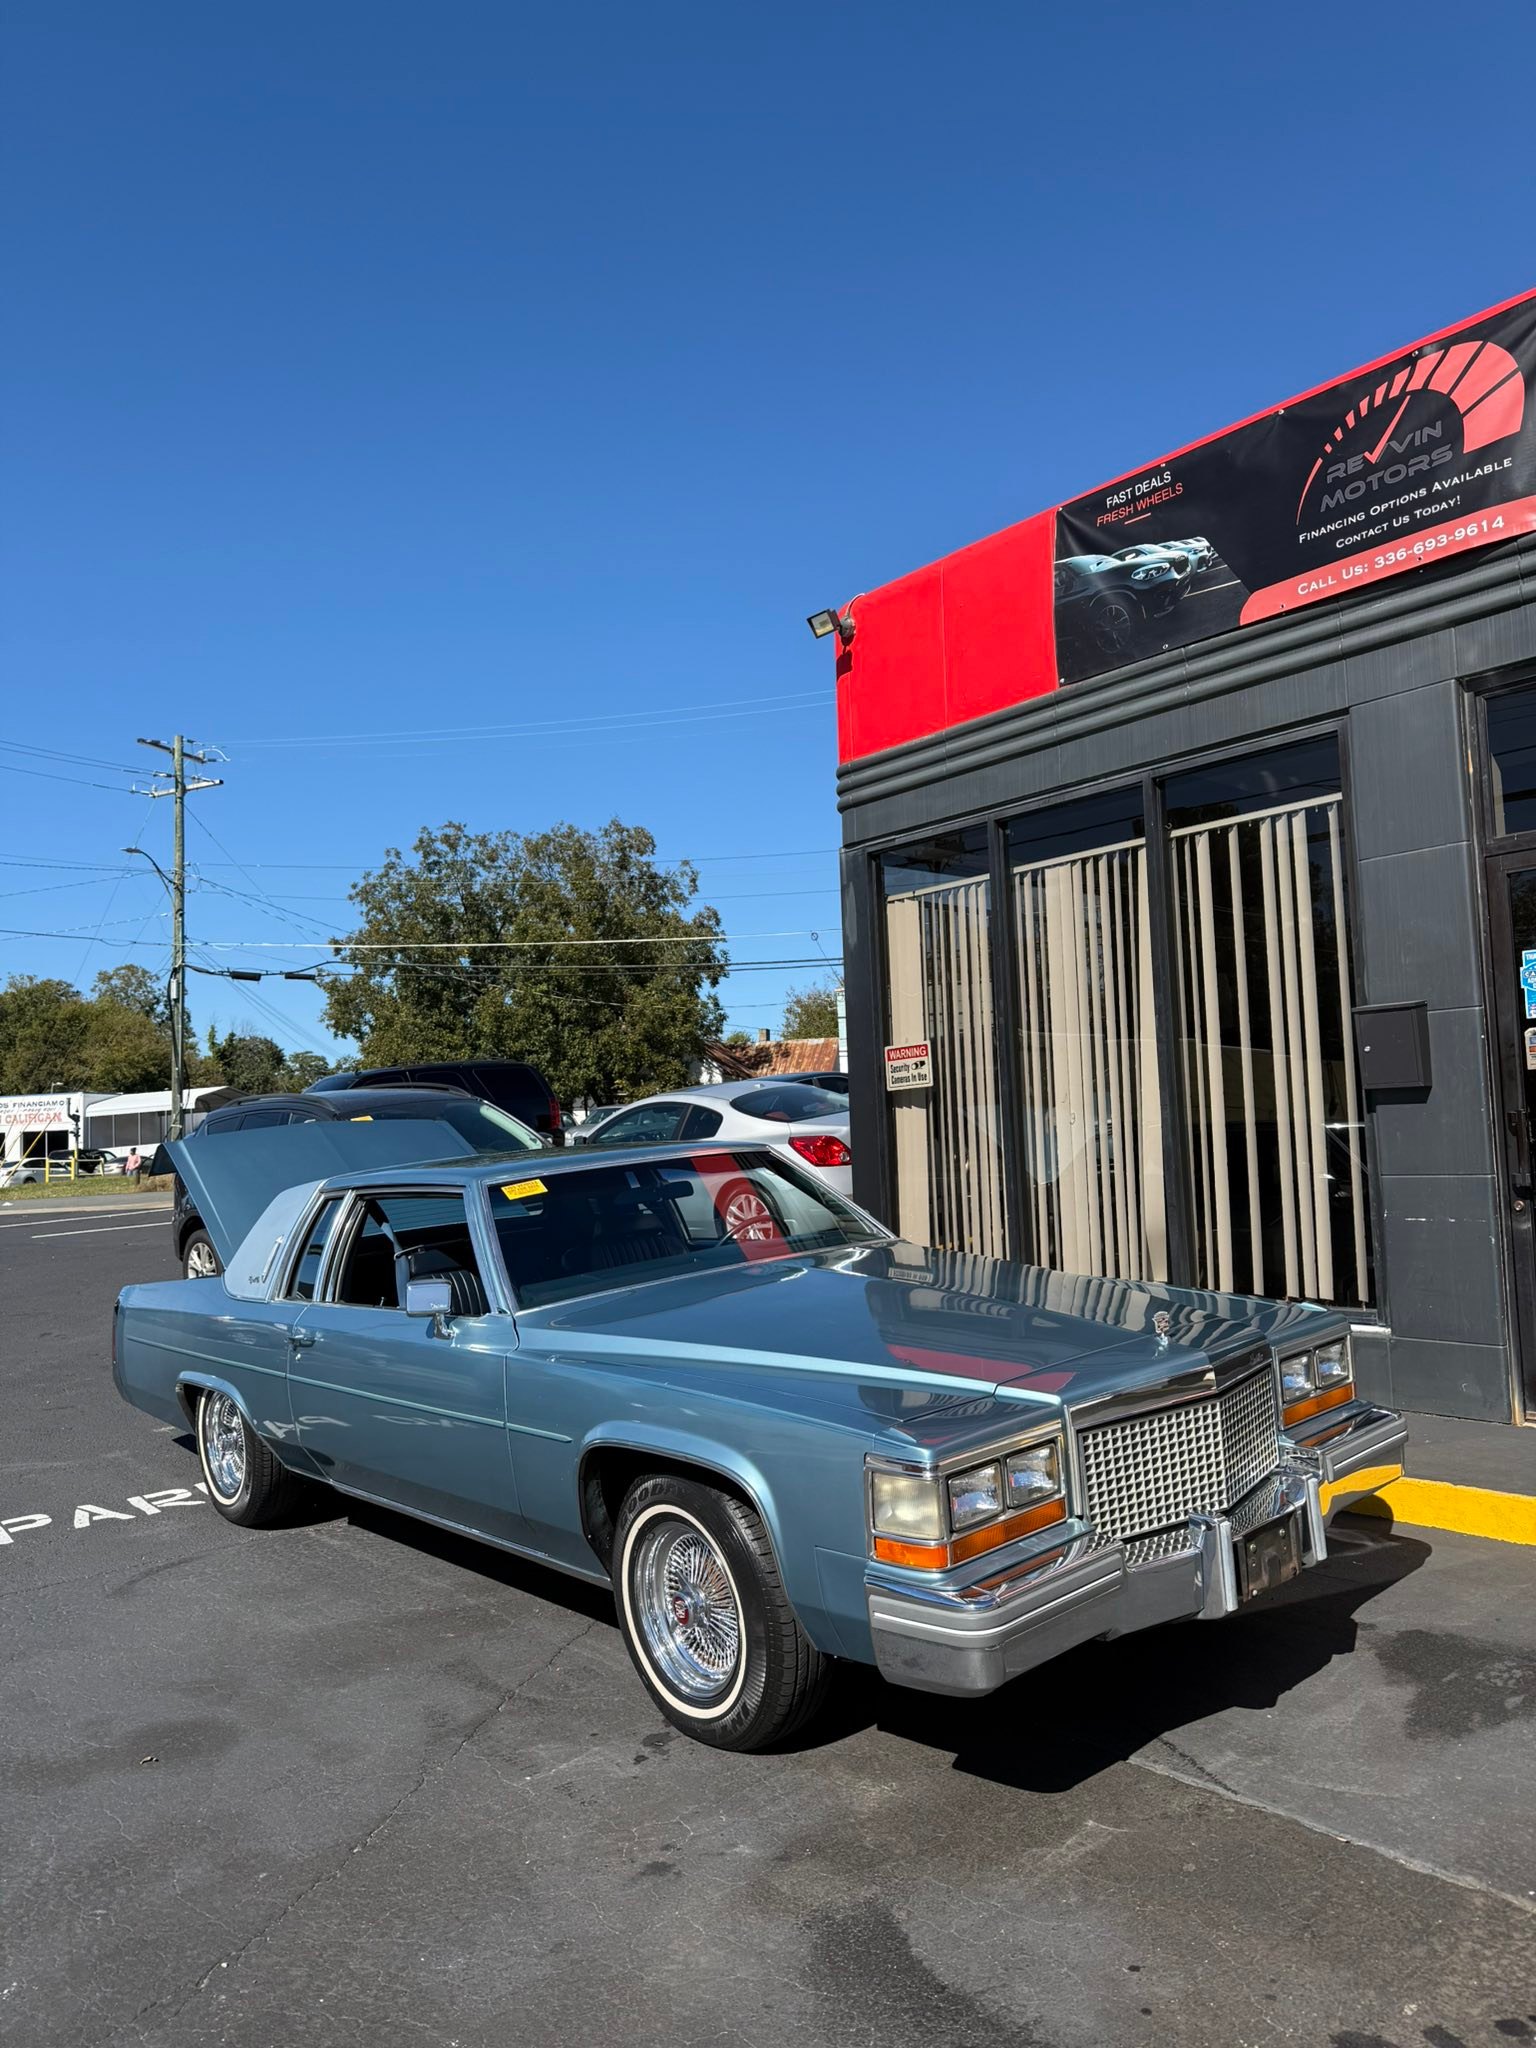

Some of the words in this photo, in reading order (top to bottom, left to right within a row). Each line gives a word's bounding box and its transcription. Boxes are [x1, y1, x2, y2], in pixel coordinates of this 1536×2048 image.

[1106, 487, 1133, 509] FAST
[1135, 471, 1172, 496] DEALS
[1298, 512, 1366, 544] FINANCING
[1369, 487, 1427, 516] OPTIONS
[1431, 457, 1513, 493] AVAILABLE
[1320, 443, 1453, 513] MOTORS
[1096, 503, 1134, 527] FRESH
[1136, 482, 1184, 511] WHEELS
[1335, 522, 1389, 548] CONTACT
[1392, 515, 1410, 527] US
[1413, 495, 1461, 519] TODAY!
[1297, 575, 1337, 595] CALL
[1342, 563, 1369, 580] US:
[1374, 515, 1505, 569] 336-693-9614
[888, 1046, 926, 1060] WARNING
[890, 1063, 910, 1074] Security
[891, 1075, 910, 1084] Cameras
[917, 1072, 927, 1081] Use
